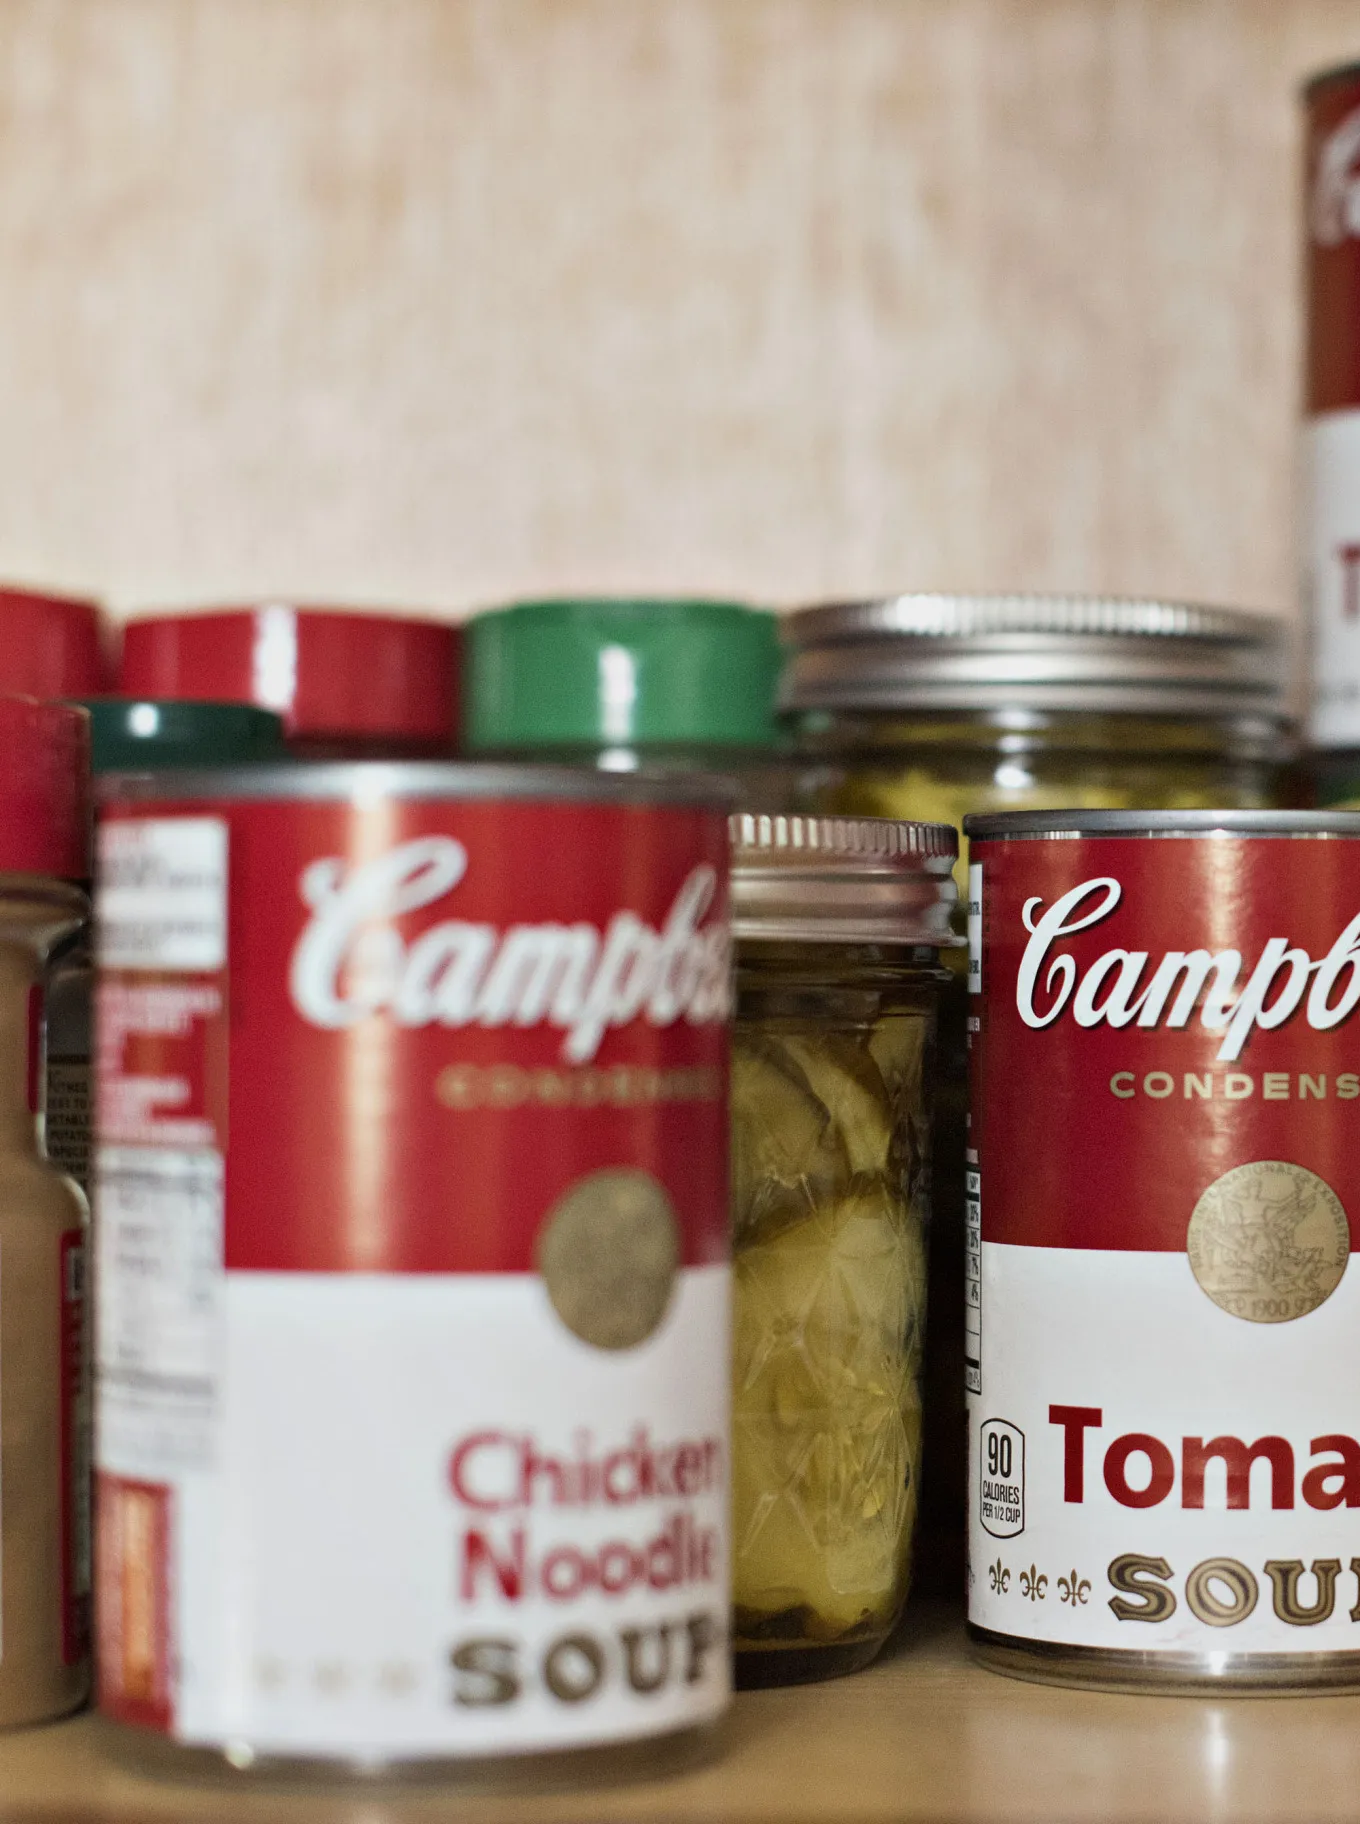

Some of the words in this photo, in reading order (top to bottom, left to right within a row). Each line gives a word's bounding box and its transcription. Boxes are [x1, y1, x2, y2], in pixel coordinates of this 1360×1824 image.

[988, 1432, 1012, 1478] 90
[982, 1480, 1020, 1505] CALORIES
[982, 1502, 993, 1518] PER
[994, 1504, 1004, 1521] 1/2
[1005, 1507, 1020, 1524] CUP
[450, 1612, 733, 1711] SOUP
